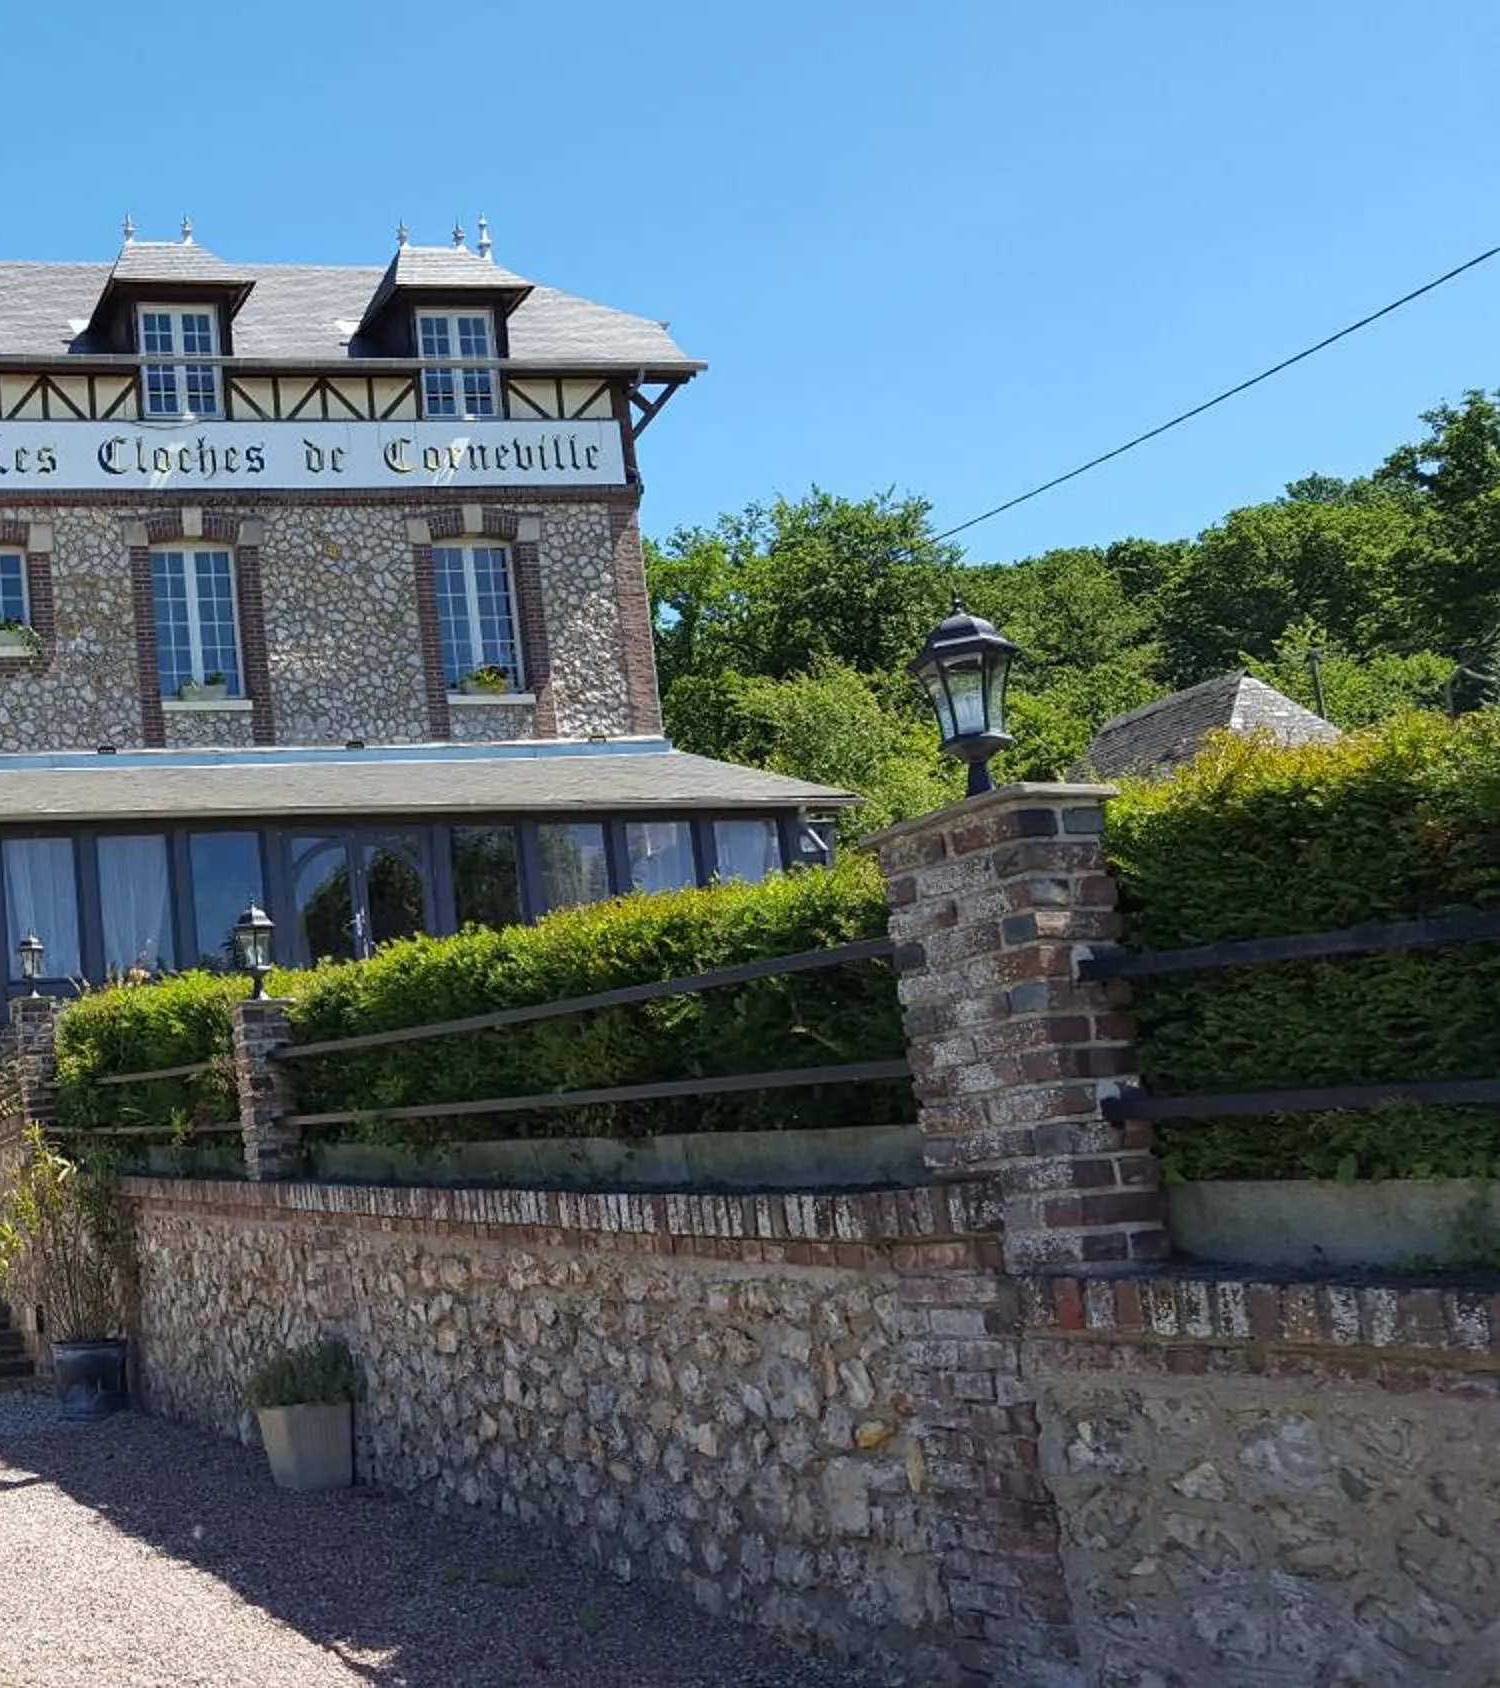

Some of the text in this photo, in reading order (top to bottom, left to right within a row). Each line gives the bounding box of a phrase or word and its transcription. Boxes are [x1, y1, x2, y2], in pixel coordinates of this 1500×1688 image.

[97, 434, 266, 480] Cloches
[303, 437, 348, 473] de
[383, 434, 602, 474] Corneville
